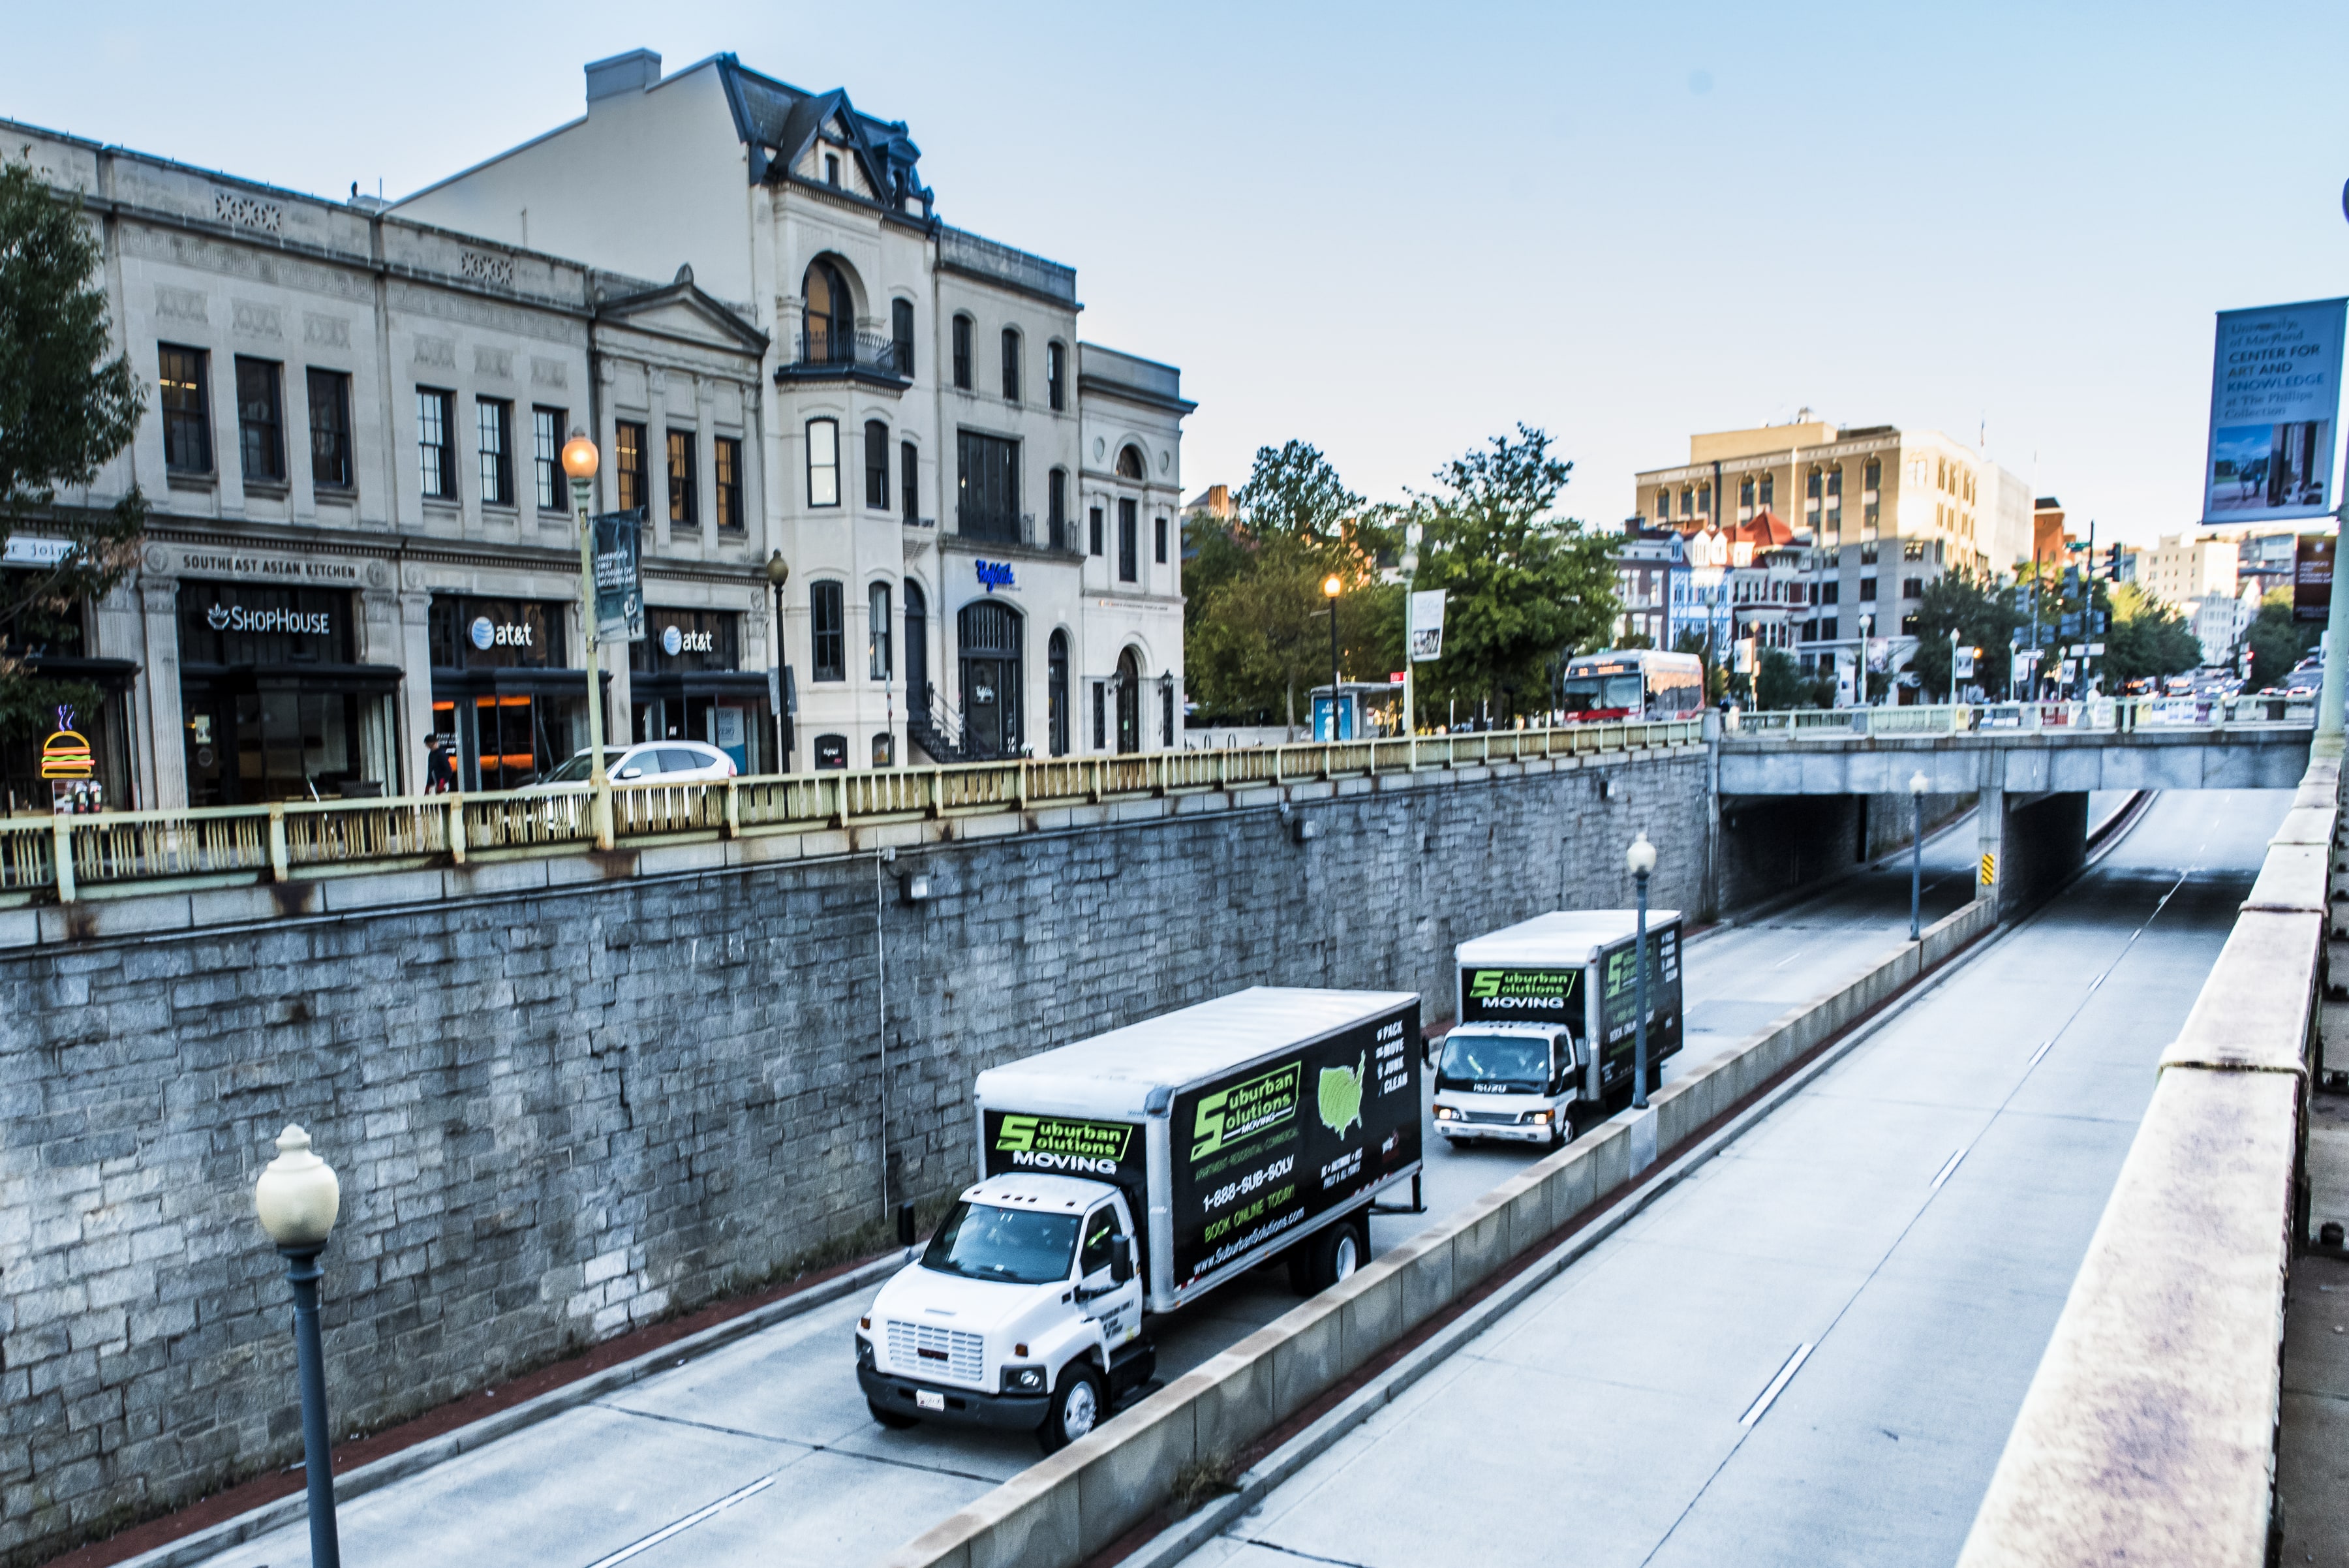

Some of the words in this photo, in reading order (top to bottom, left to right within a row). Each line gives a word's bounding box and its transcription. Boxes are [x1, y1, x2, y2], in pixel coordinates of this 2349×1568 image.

[2246, 330, 2304, 346] Maryland
[2228, 348, 2286, 364] CENTER
[2290, 344, 2321, 357] FOR
[2228, 364, 2257, 378] ART
[2259, 361, 2293, 375] AND
[2227, 372, 2325, 392] KNOWLEDGE
[2241, 394, 2265, 406] The
[2269, 392, 2314, 404] Phillips
[2224, 407, 2286, 419] Collection
[183, 555, 258, 573] SOUTHEAST
[262, 560, 301, 576] ASIAN
[306, 562, 356, 579] KITCHEN
[496, 621, 533, 647] at&t
[683, 629, 713, 652] at&t
[1482, 996, 1565, 1009] MOVING
[1473, 1083, 1507, 1094] ISUZU
[1240, 1111, 1277, 1135] MOVING
[1012, 1149, 1118, 1175] MOVING
[1203, 1154, 1295, 1213] 1-888-SUB-SOLV
[1204, 1214, 1231, 1244] BOOK
[1233, 1197, 1265, 1228] ONLINE
